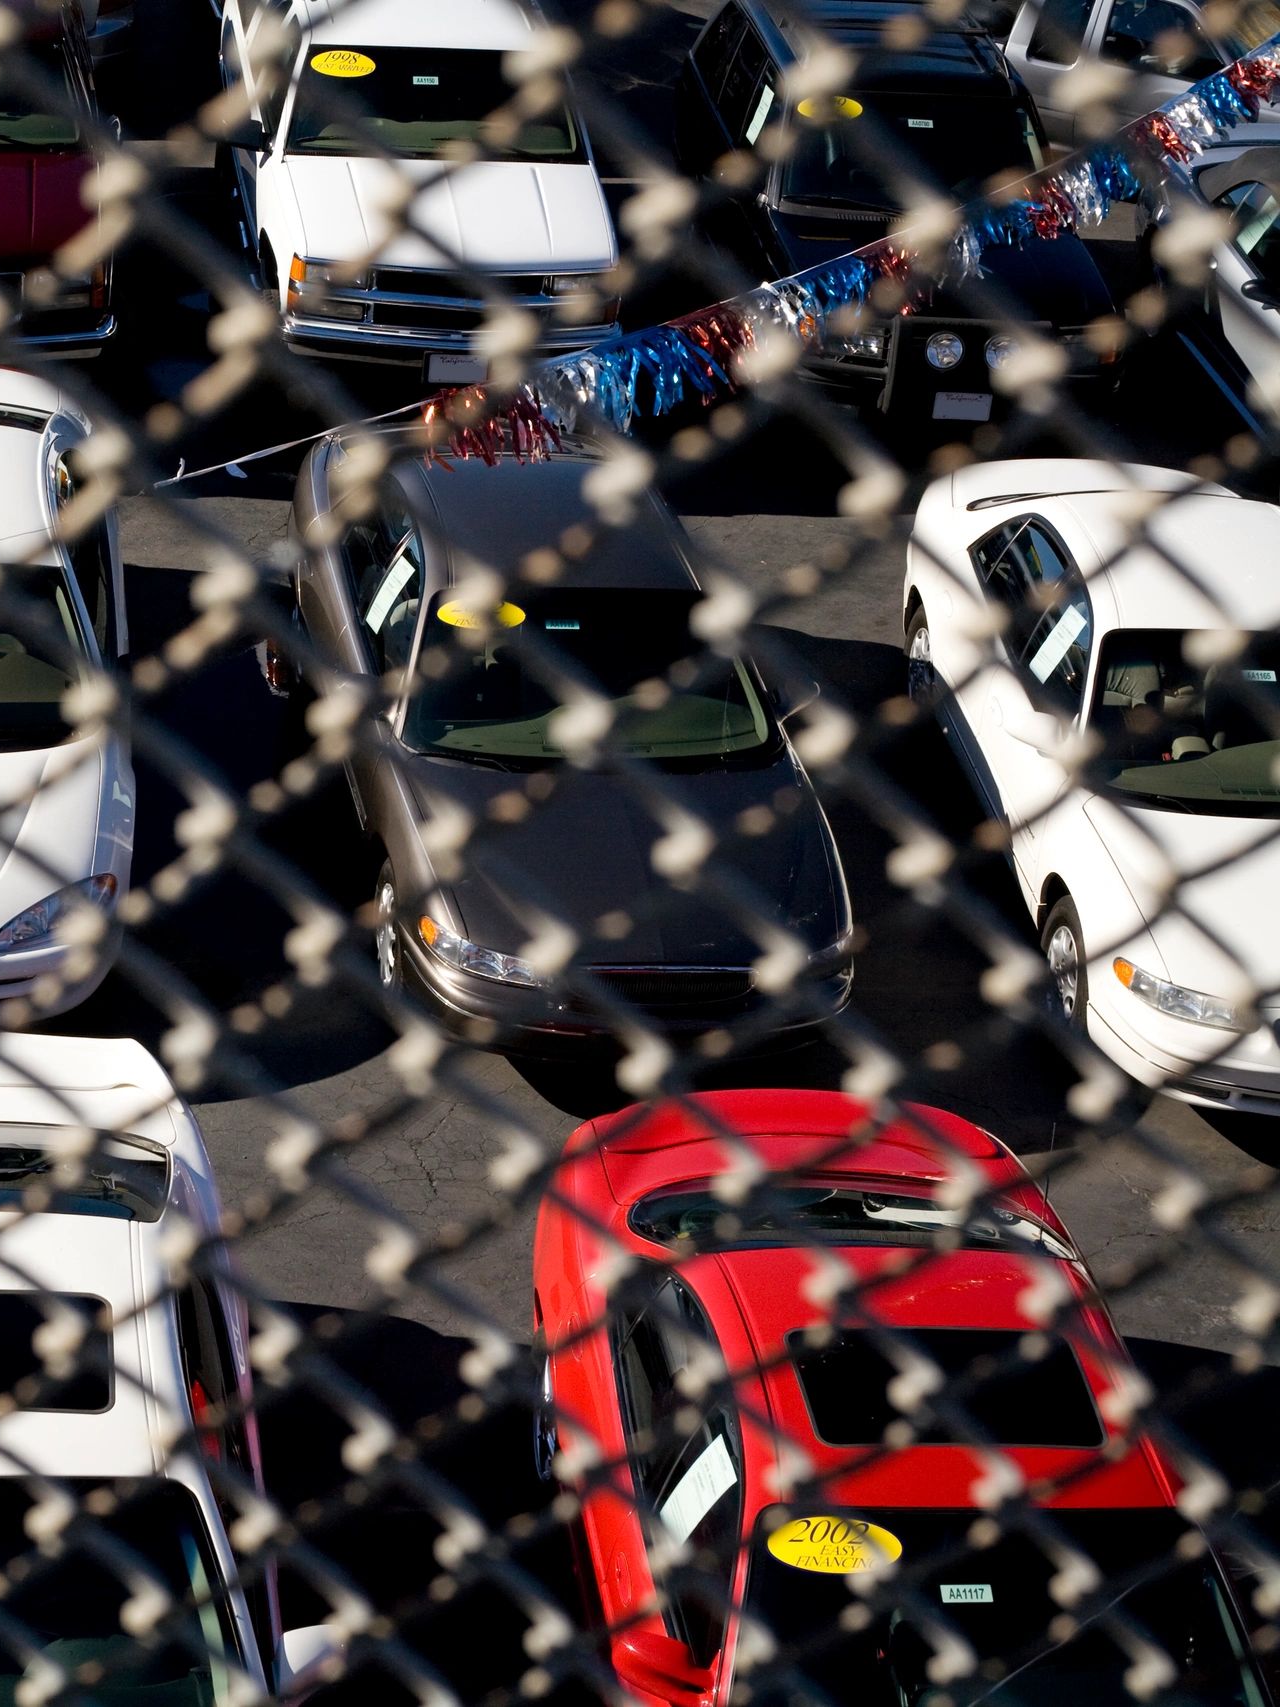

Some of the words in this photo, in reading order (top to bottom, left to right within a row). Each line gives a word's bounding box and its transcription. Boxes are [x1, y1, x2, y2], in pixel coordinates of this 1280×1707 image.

[323, 52, 362, 64] 1998
[788, 1519, 870, 1544] 2002
[820, 1545, 862, 1556] EASY
[949, 1588, 985, 1600] AA1117
